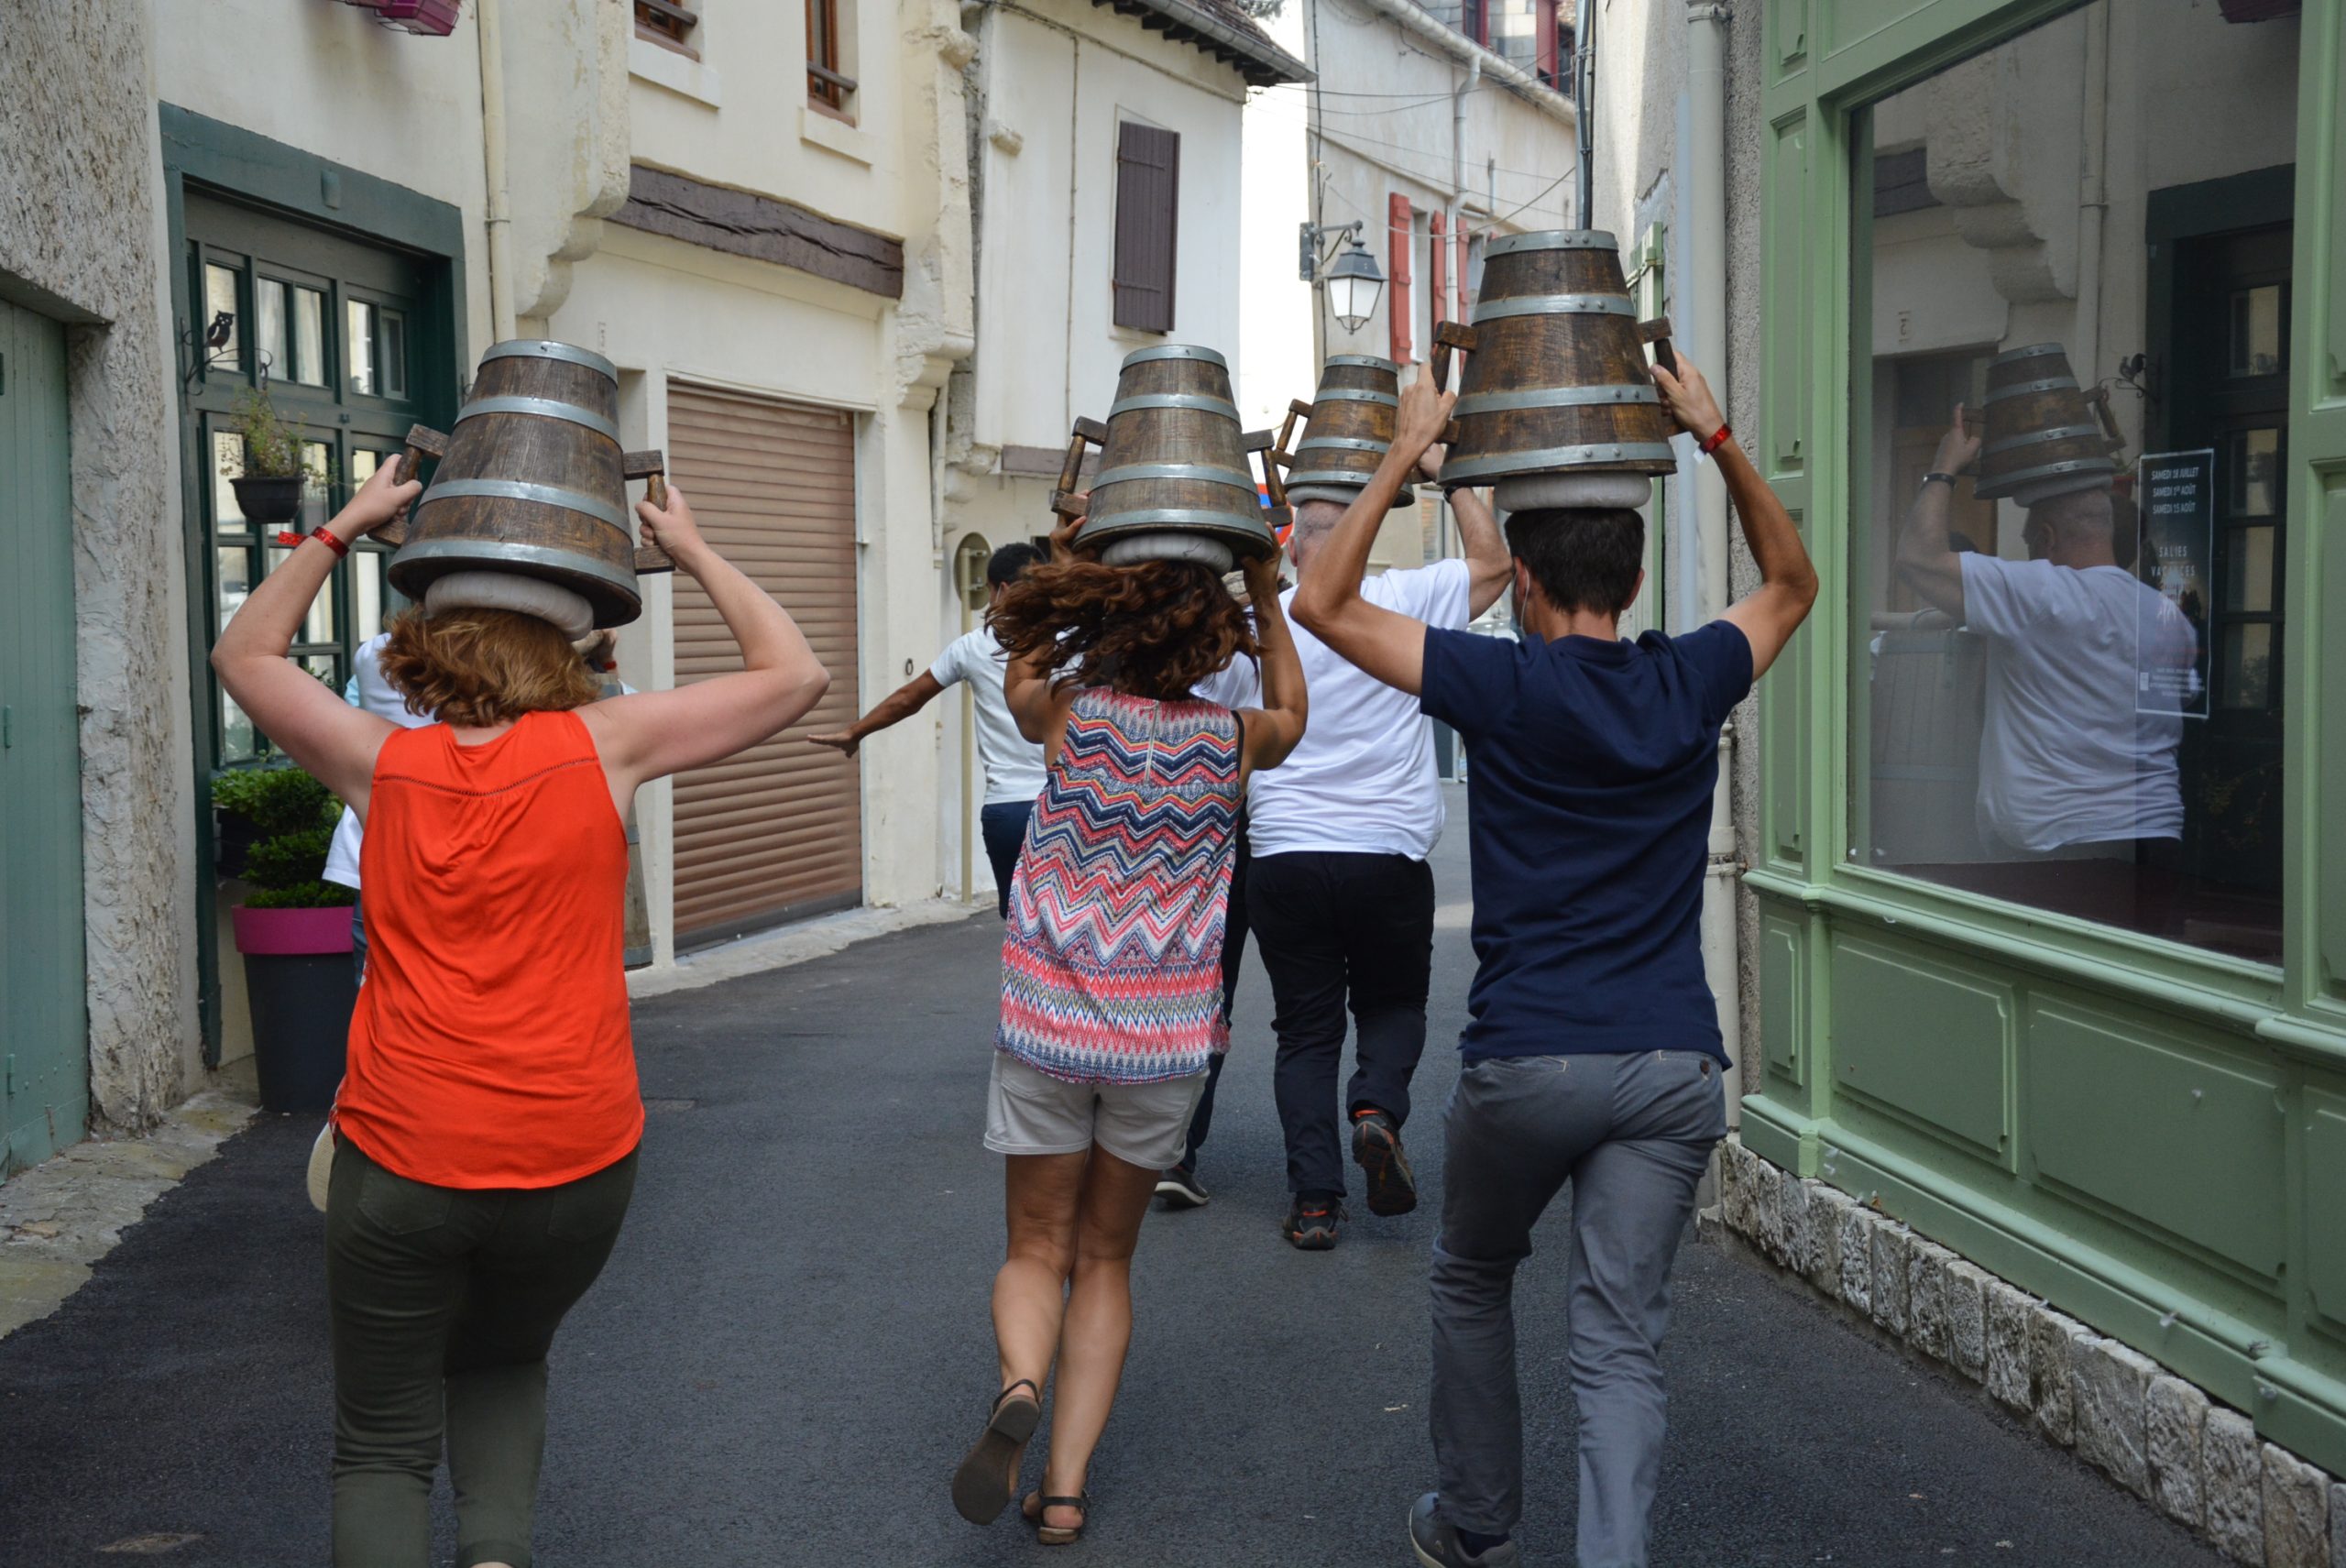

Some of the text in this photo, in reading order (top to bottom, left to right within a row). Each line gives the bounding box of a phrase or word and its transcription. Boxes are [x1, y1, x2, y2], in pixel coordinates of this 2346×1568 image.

[2151, 469, 2172, 480] SAMEDI
[2179, 467, 2199, 477] JUILLET
[2153, 486, 2173, 497] SAMEDI
[2153, 503, 2173, 514] SAMEDI
[2159, 545, 2187, 558] SALIES
